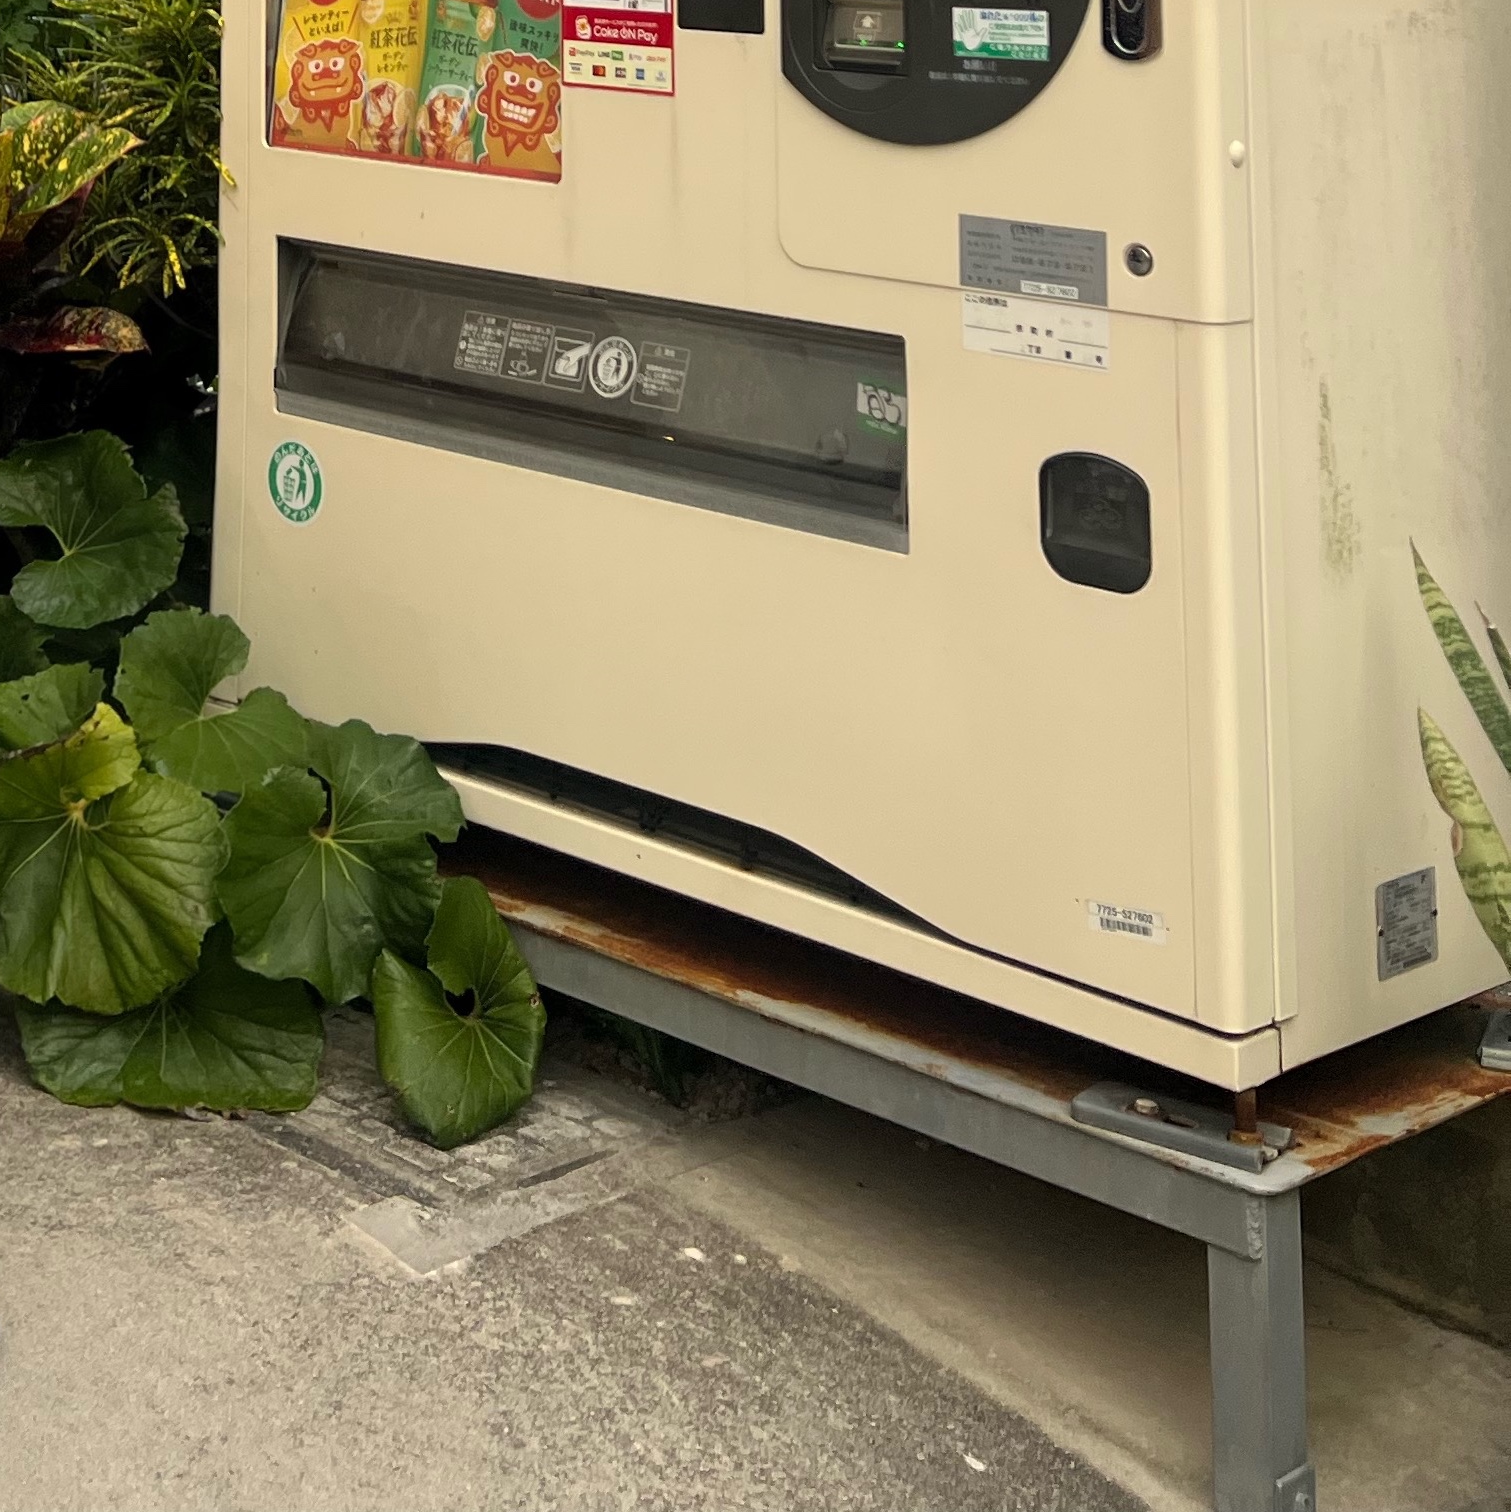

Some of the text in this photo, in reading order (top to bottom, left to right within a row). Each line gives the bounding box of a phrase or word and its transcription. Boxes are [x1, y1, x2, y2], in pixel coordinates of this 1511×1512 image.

[303, 10, 350, 25] レモンティー
[308, 21, 345, 37] といえば!
[369, 28, 419, 49] 紅茶花伝
[593, 25, 659, 45] Coke ON Pay
[430, 28, 479, 58] 紅茶花伝
